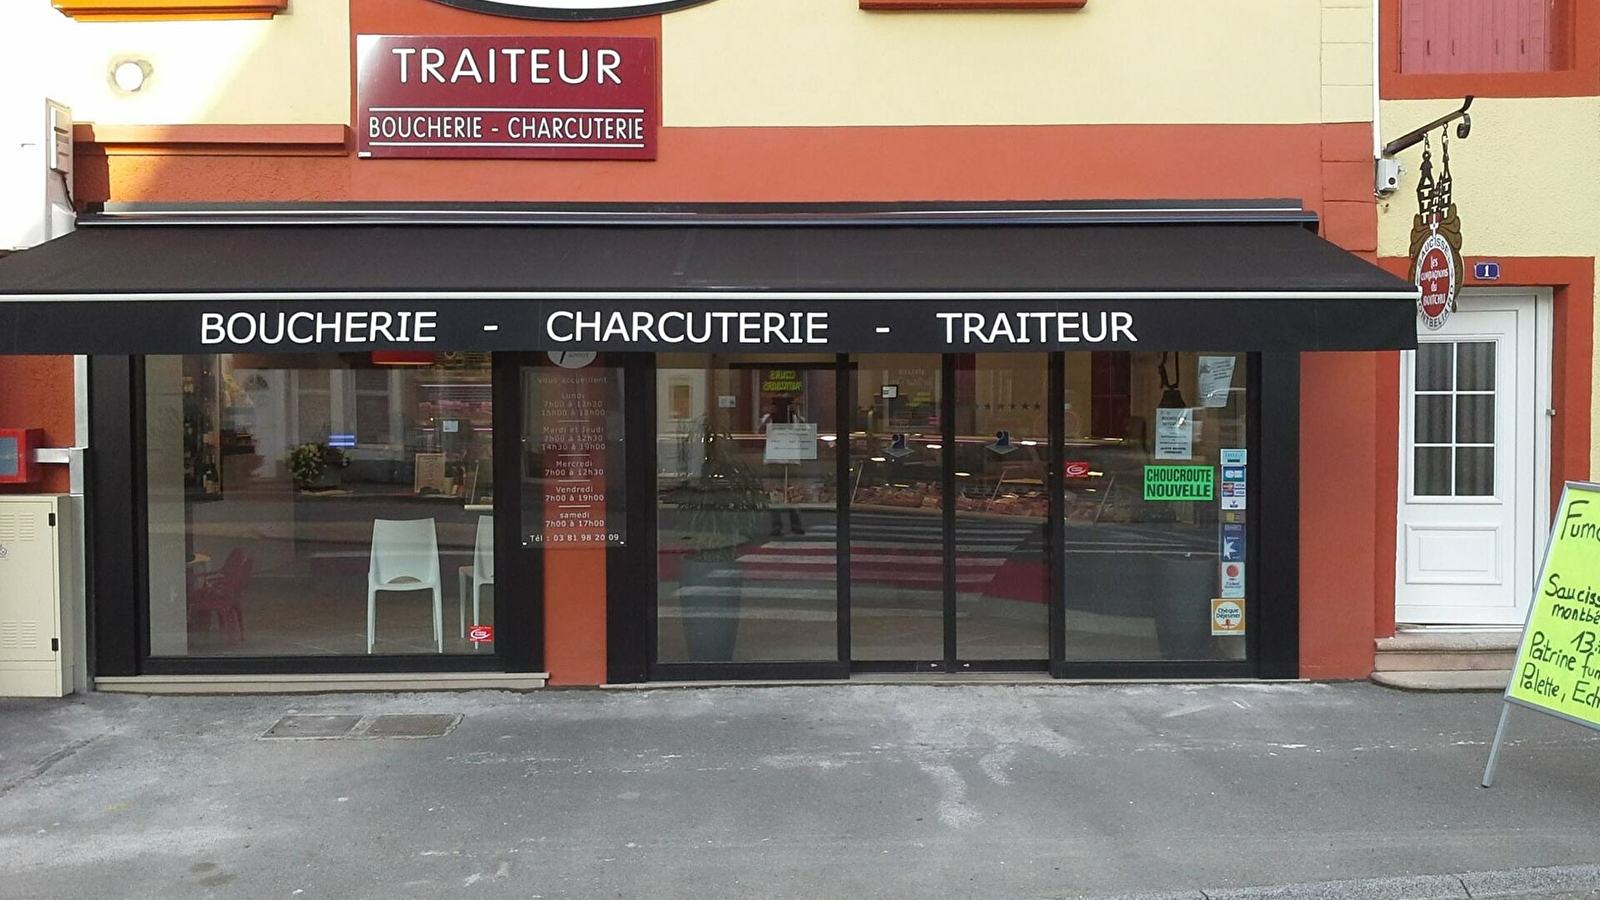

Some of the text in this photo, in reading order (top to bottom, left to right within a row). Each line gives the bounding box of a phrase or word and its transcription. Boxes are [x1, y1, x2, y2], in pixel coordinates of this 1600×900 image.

[392, 48, 622, 85] TRAITEUR
[369, 117, 482, 138] BOUCHERIE
[508, 118, 643, 140] CHARCUTERIE
[1484, 264, 1490, 277] 1
[200, 311, 437, 344] BOUCHERIE
[546, 311, 829, 344] CHARCUTERIE
[936, 312, 1137, 343] TRAITEUR
[561, 392, 585, 400] Lundi
[577, 400, 603, 408] 12h30
[543, 426, 567, 434] Mardi
[578, 468, 604, 476] 12h30
[1146, 469, 1211, 482] CHOUCROUTE
[1146, 484, 1211, 497] NOUVELLE
[545, 494, 604, 502] 7h00 à 19h00
[559, 511, 590, 519] samedi
[545, 519, 605, 528] 7h00 à 17h00
[553, 534, 564, 542] 03
[567, 534, 577, 542] 81
[608, 533, 619, 541] 09
